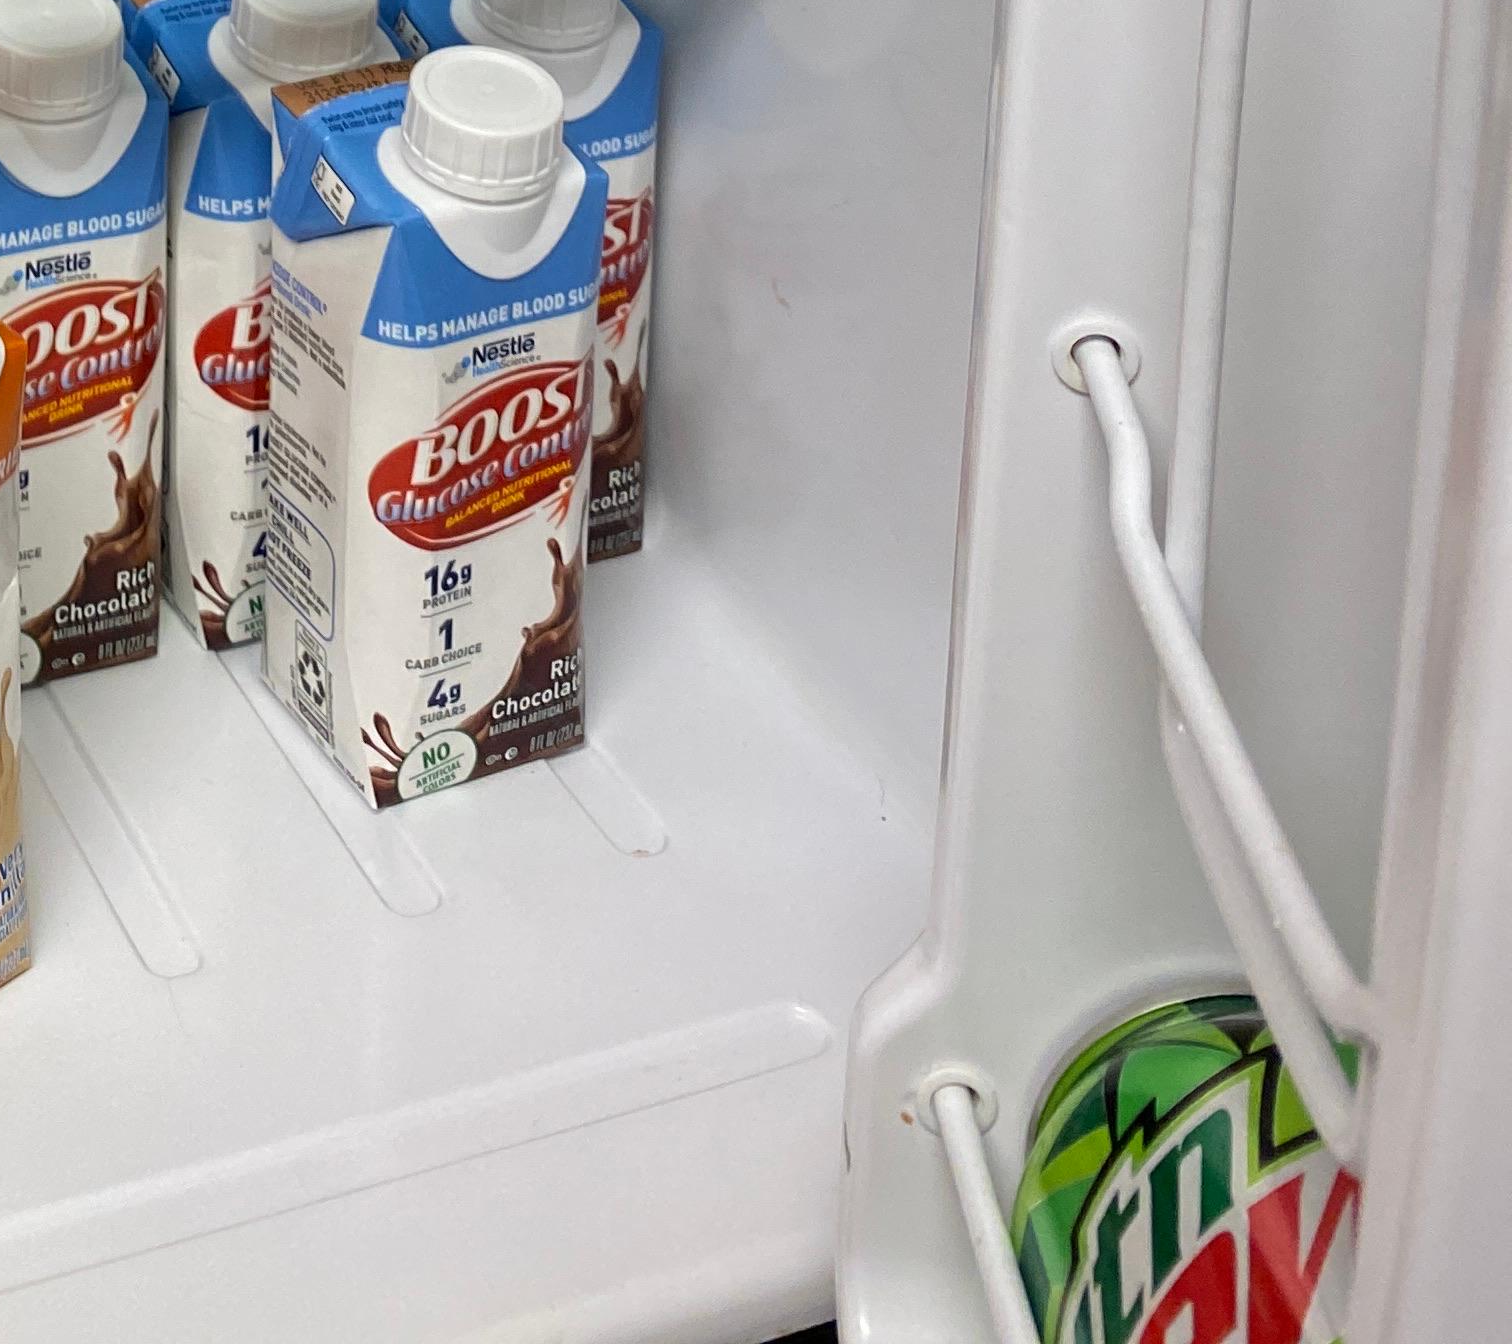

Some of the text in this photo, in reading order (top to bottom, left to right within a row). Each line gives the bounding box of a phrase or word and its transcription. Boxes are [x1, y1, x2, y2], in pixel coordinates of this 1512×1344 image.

[197, 195, 255, 216] HELPS
[67, 213, 123, 236] BLOOD
[377, 293, 565, 344] HELPS MANAGE BLOOD
[409, 345, 595, 487] BOOST
[375, 459, 501, 526] Glucose
[445, 458, 574, 529] BALANCED NUTRITIONAL
[491, 490, 527, 514] DRINK
[116, 560, 156, 591] Rich
[424, 559, 473, 597] 16g
[422, 586, 473, 611] PROTEIN
[438, 618, 454, 650] 1
[404, 642, 483, 671] CARB CHOICE
[426, 678, 462, 708] 4g
[419, 704, 467, 726] SUGARS
[421, 741, 451, 770] NO
[414, 762, 462, 789] ARTIFICIAL
[421, 773, 458, 794] COLORS
